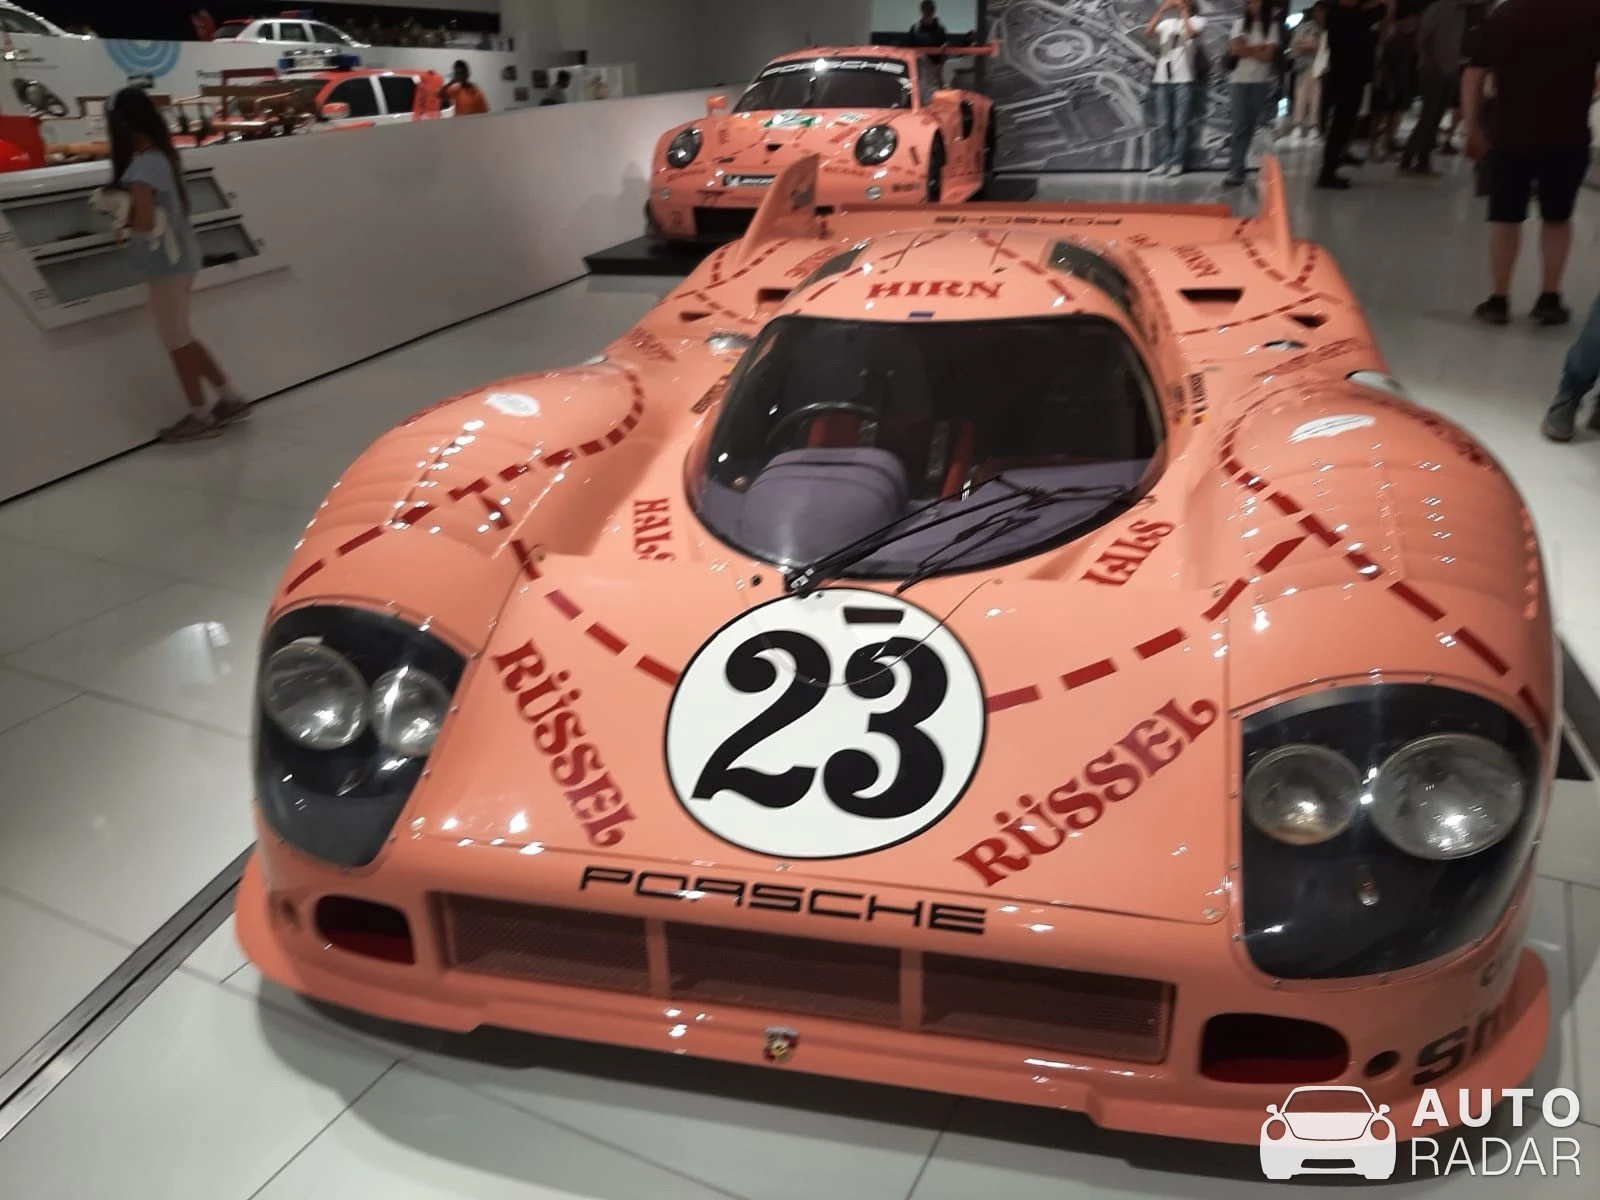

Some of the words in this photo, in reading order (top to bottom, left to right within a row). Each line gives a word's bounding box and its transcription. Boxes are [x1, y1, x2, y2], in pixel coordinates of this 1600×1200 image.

[866, 279, 1005, 299] HIRN
[491, 638, 637, 848] RÜSSEL
[690, 630, 948, 819] 23
[954, 697, 1219, 888] RÜSSEL
[578, 865, 988, 936] PORSCHE
